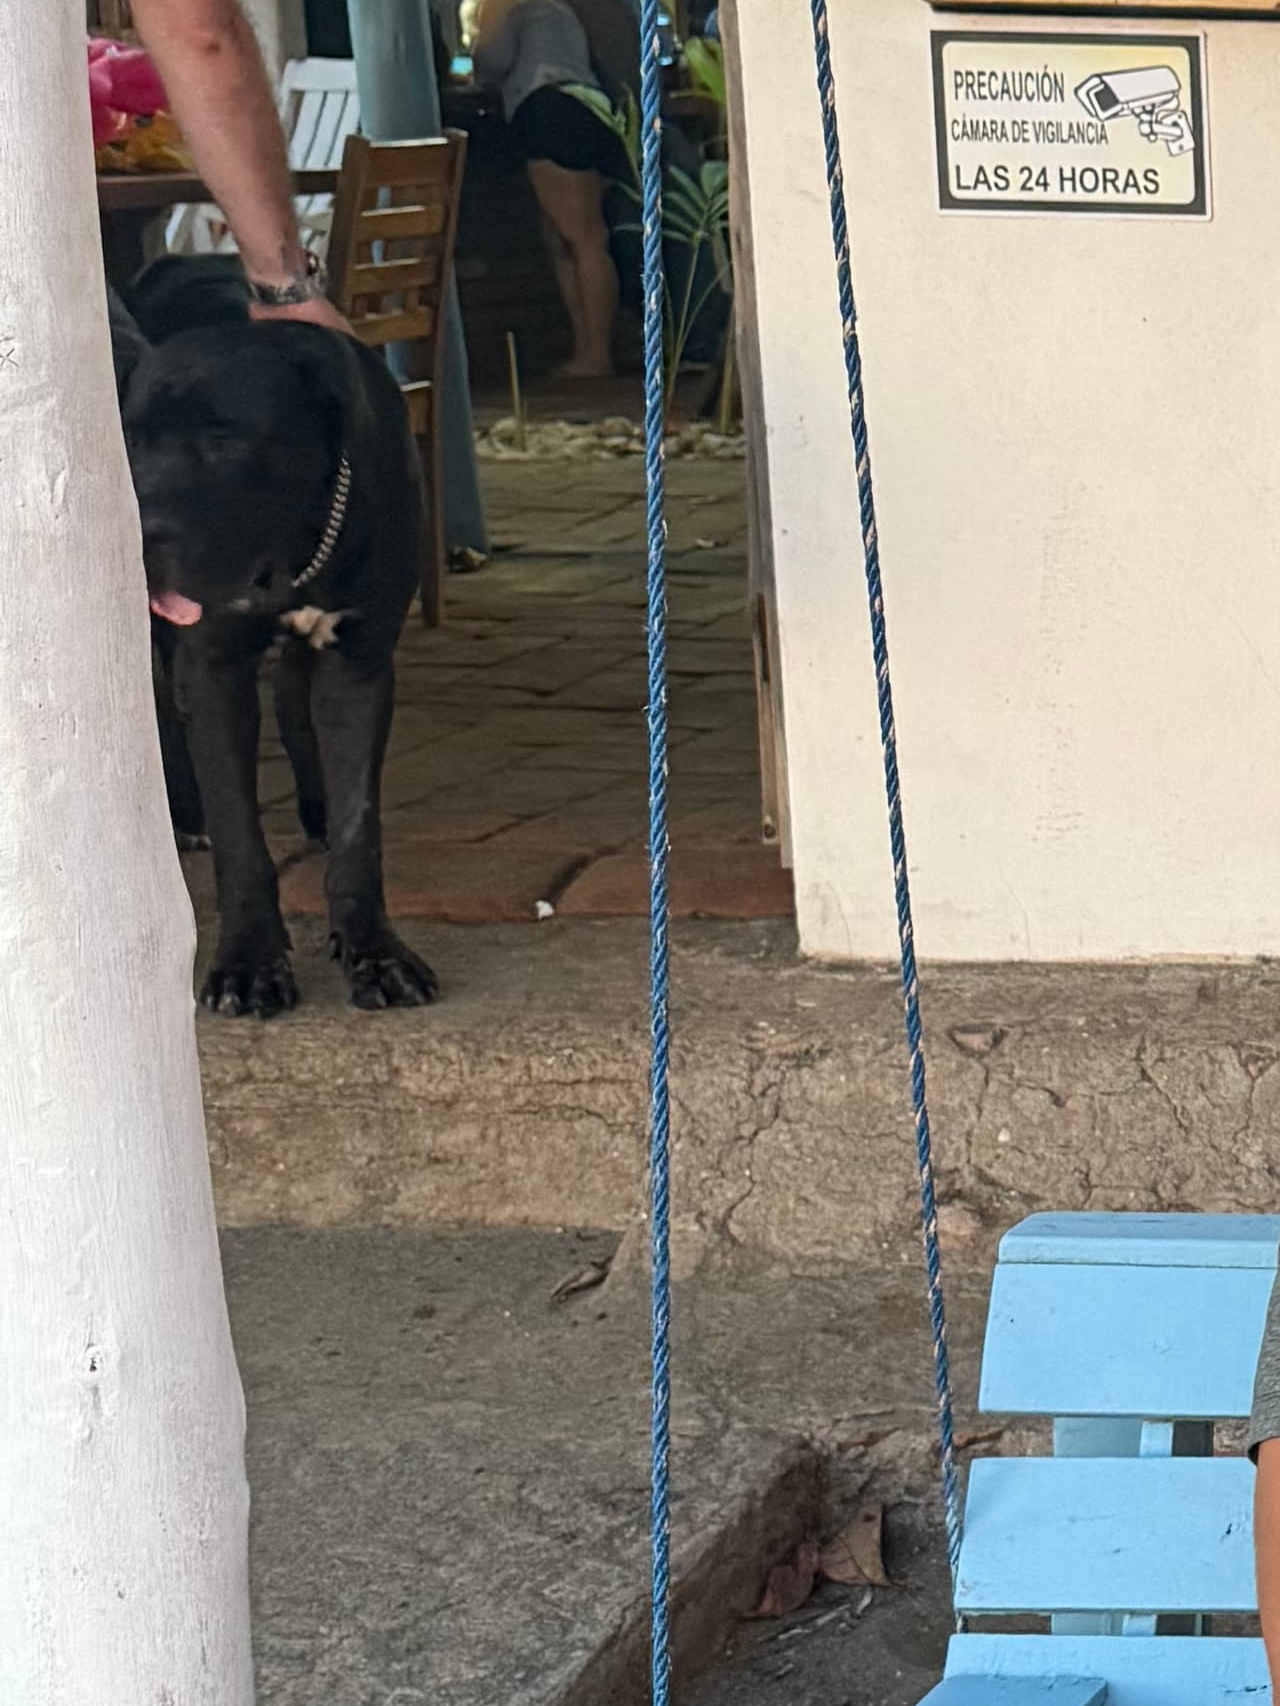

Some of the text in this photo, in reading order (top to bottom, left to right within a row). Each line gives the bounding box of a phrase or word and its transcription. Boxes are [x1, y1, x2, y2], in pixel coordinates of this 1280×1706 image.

[953, 64, 1065, 103] PRECAUCIÓN
[951, 114, 1109, 145] CÁMARA DE VIGILANCIA
[955, 165, 1160, 194] LAS 24 HORAS
